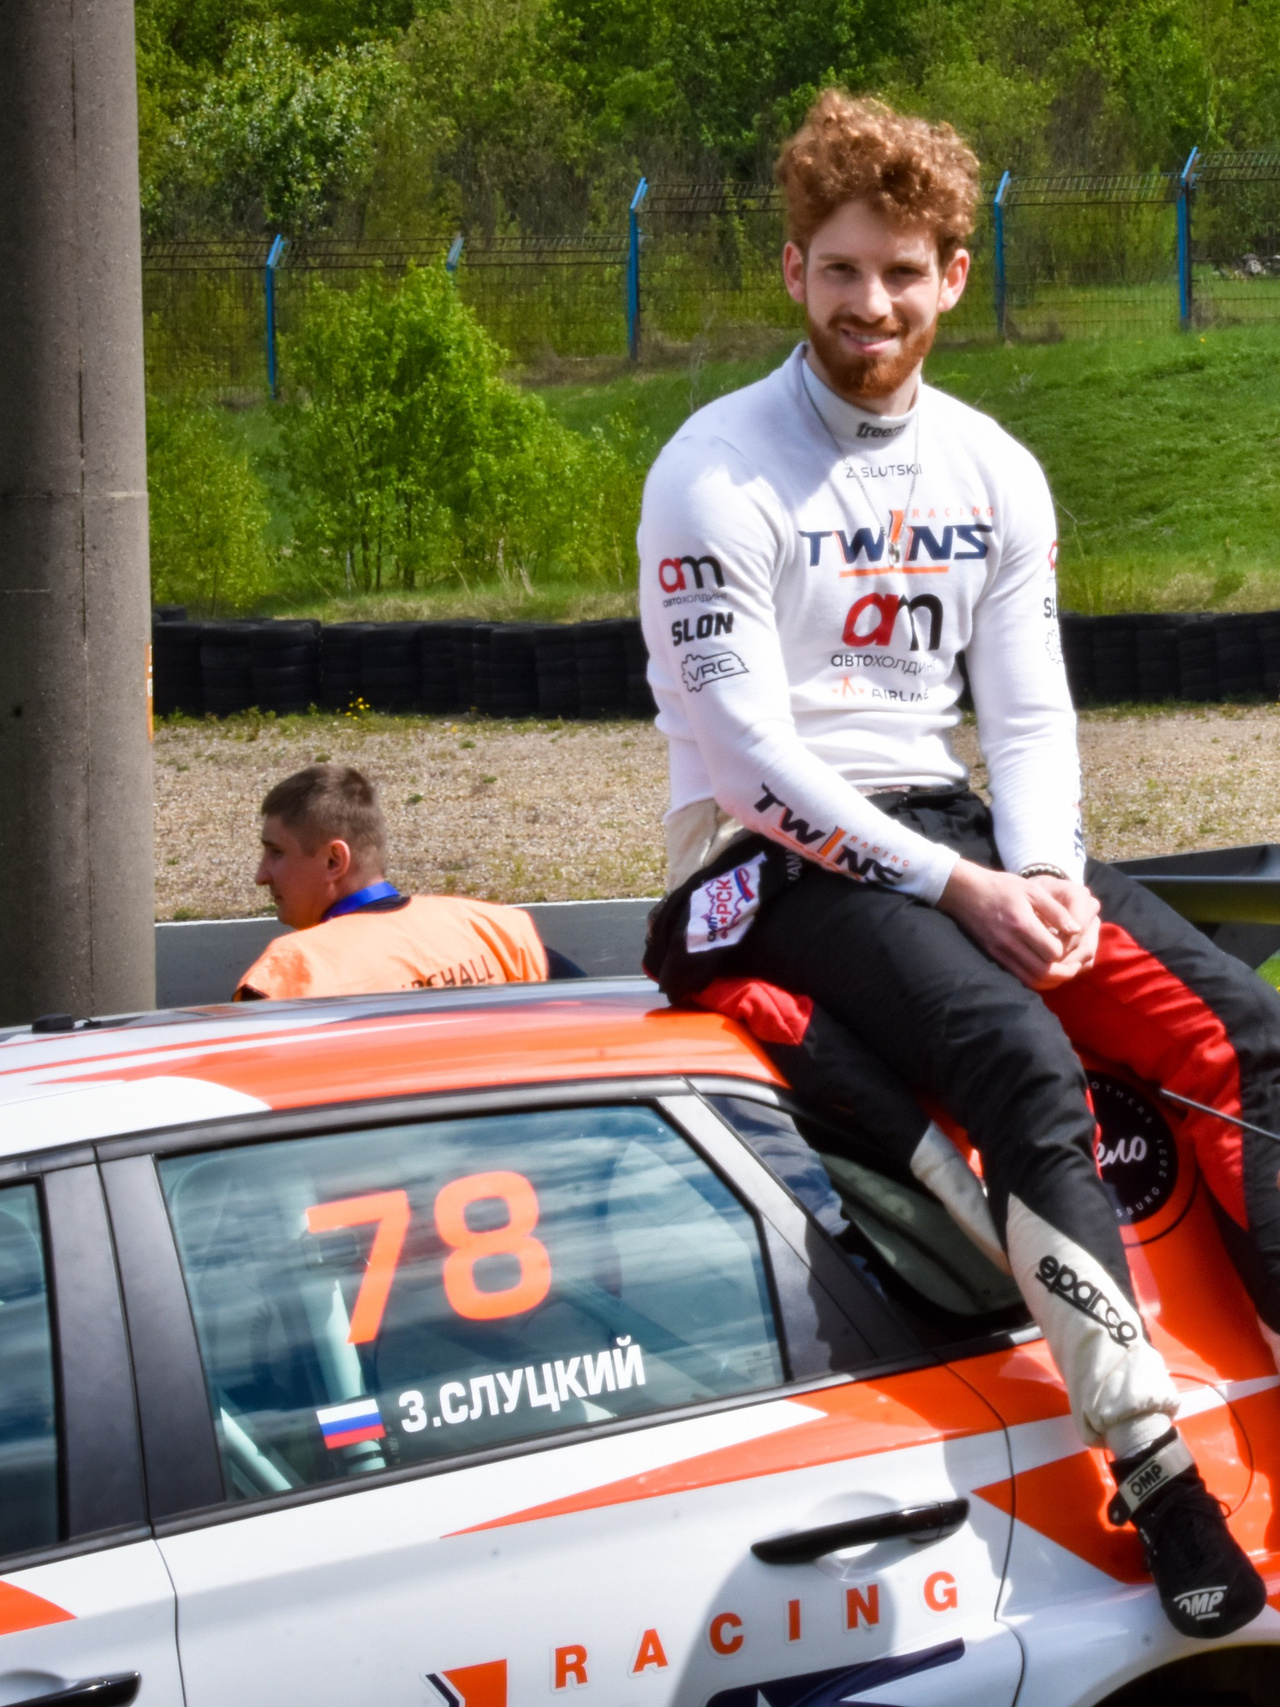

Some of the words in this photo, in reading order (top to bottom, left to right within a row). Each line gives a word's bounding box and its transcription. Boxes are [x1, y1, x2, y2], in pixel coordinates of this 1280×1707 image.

[912, 507, 995, 518] RACING
[798, 510, 993, 566] TWINS
[658, 555, 725, 593] am
[671, 611, 734, 647] SLON
[841, 592, 944, 651] am
[688, 658, 735, 682] VRC
[831, 654, 938, 676] автохолдин
[850, 836, 910, 867] RACING
[304, 1170, 552, 1345] 78
[1035, 1255, 1138, 1349] sparco
[399, 1334, 647, 1433] З.СЛУЦКИЙ
[1130, 1463, 1163, 1497] OMP
[555, 1570, 959, 1689] RACING
